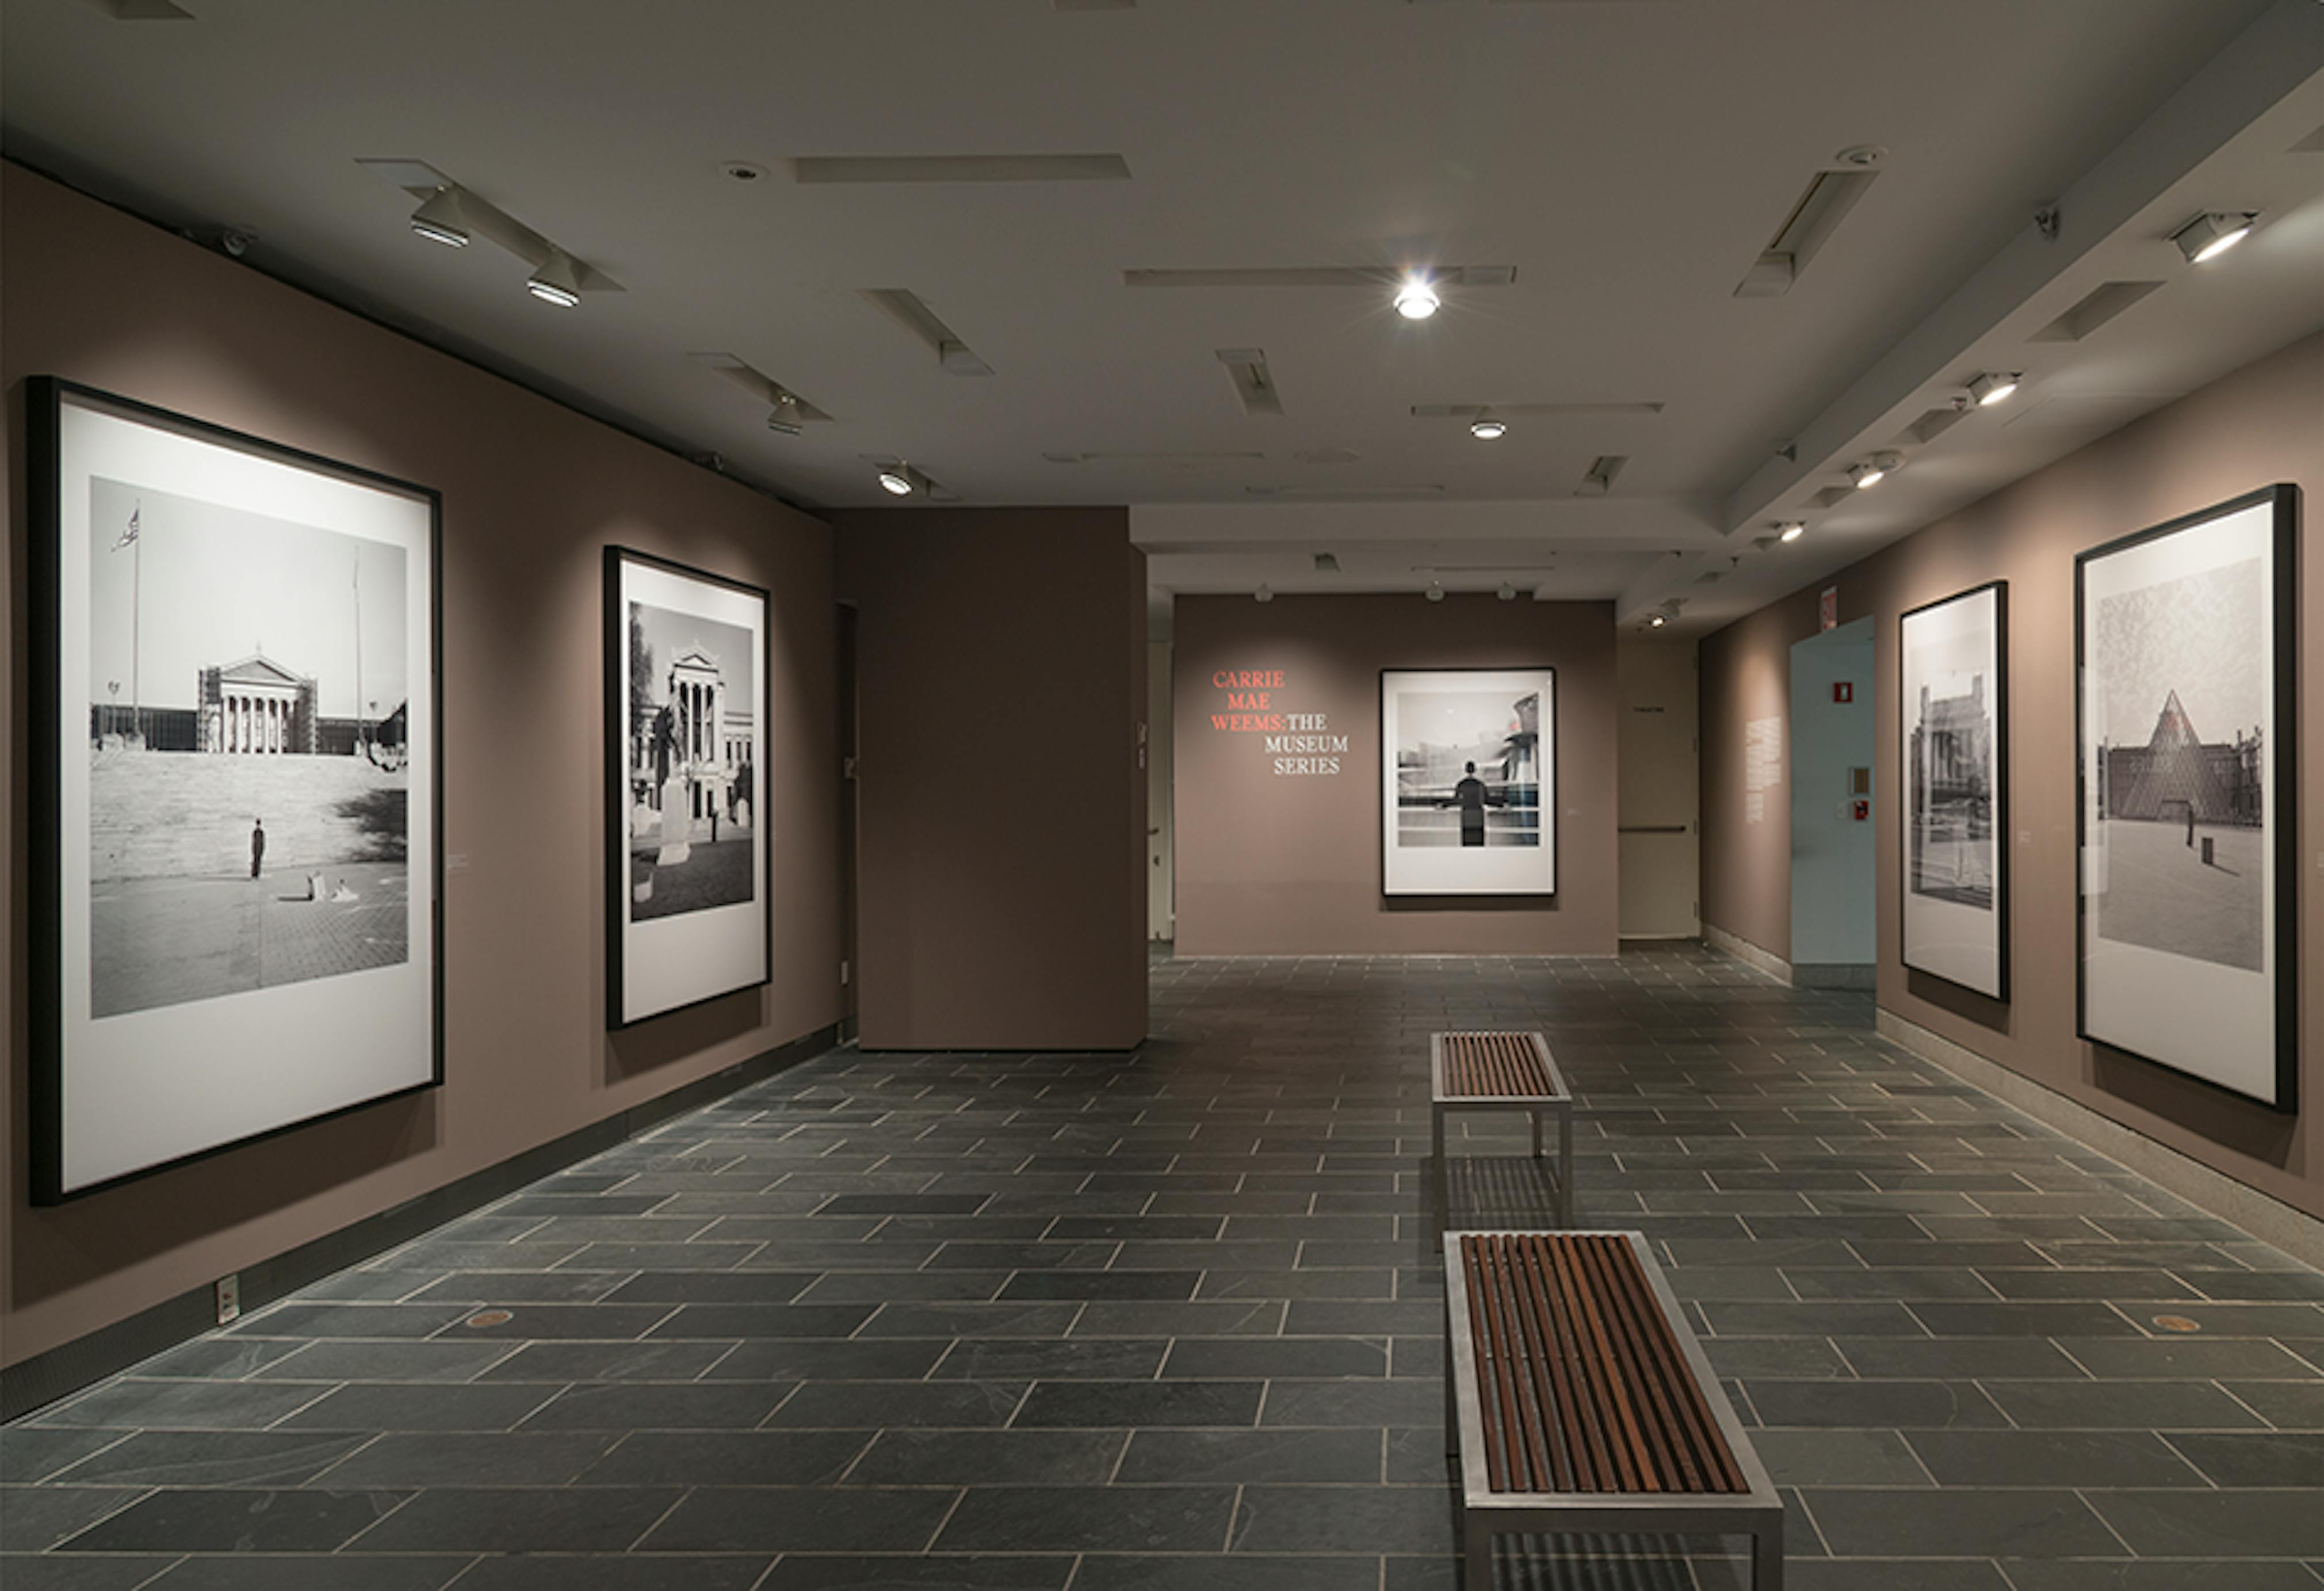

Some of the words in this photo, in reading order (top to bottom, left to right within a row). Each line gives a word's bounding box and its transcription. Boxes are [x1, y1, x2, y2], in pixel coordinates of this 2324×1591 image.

[1212, 670, 1285, 688] CARRIE
[1227, 692, 1271, 710] MAE
[1211, 714, 1286, 731] WEEMS:
[1287, 714, 1327, 730] THE
[1265, 735, 1348, 753] MUSEUM
[1274, 757, 1341, 774] SERIES
